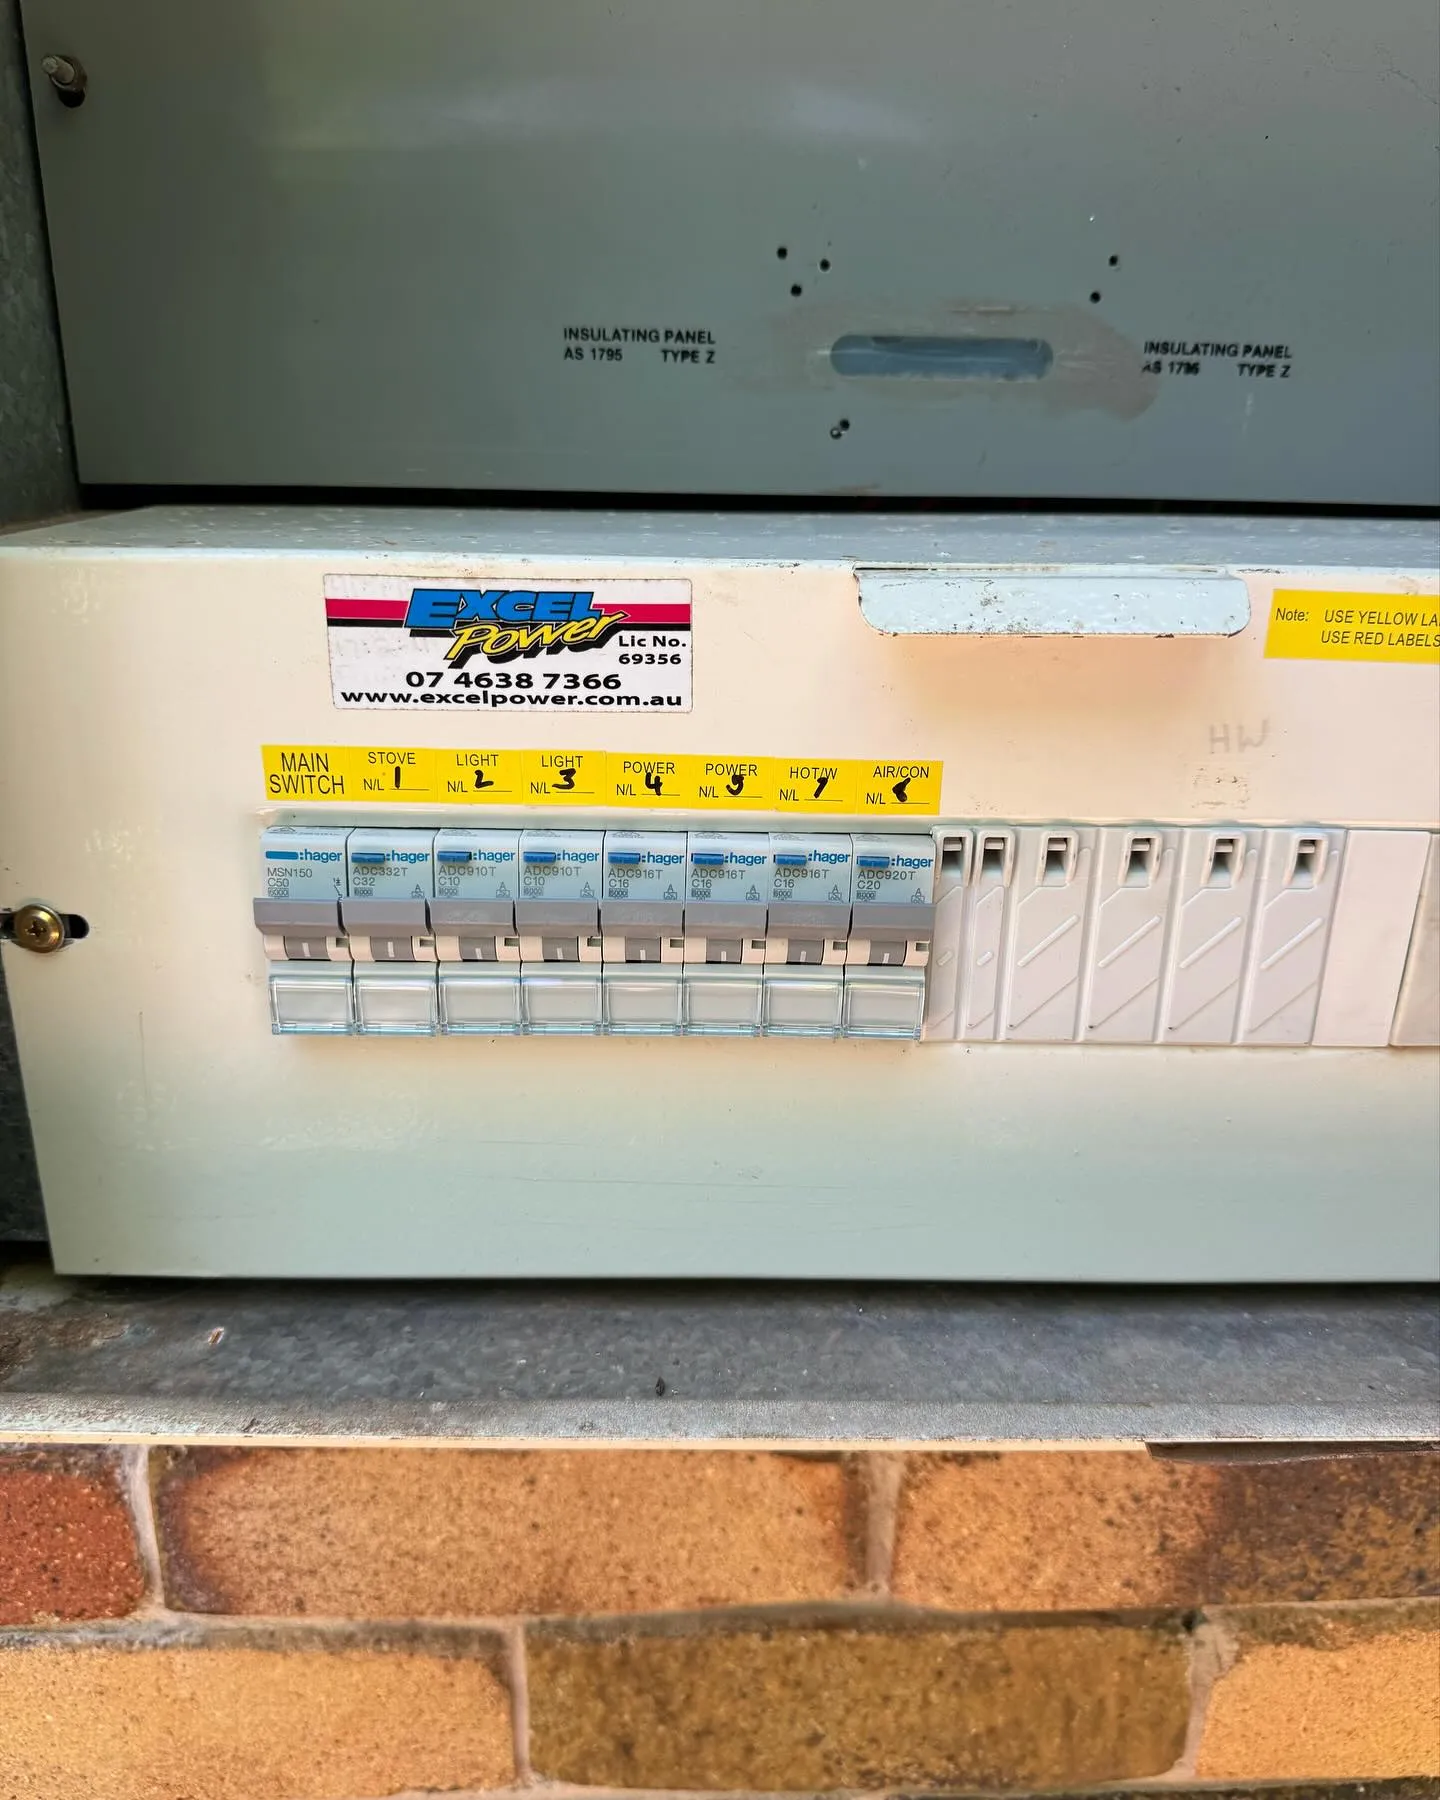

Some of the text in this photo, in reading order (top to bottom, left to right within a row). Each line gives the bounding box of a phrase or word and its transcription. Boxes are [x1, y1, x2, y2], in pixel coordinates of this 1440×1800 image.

[563, 327, 716, 345] INSULATING PANEL
[563, 346, 716, 364] AS 1795 TYPE Z
[1143, 341, 1292, 359] INSULATING PANEL
[1237, 363, 1275, 378] TYPE
[1280, 364, 1292, 378] Z
[404, 588, 602, 629] EXCEL
[1275, 607, 1440, 627] Note: USE YELLOW LA
[444, 611, 629, 660] Power
[618, 635, 686, 648] Lic No.
[1321, 630, 1440, 648] USE RED LABELS
[618, 653, 682, 665] 69356
[405, 672, 622, 690] 07 4638 7366
[341, 690, 683, 708] www.excelpower.com.au
[281, 752, 330, 773] MAIN
[367, 752, 417, 765] STOVE
[456, 754, 500, 767] LIGHT
[541, 755, 584, 768] LIGHT
[623, 761, 675, 775] POWER
[705, 763, 758, 777] POWER
[789, 766, 838, 780] HOT/W
[873, 765, 930, 778] AIR/CON
[394, 766, 401, 789] 1
[474, 769, 494, 789] 2
[551, 767, 577, 790] 3
[644, 771, 663, 796] 4
[269, 774, 345, 795] SWITCH
[363, 778, 385, 792] N/L
[447, 780, 469, 793] N/L
[530, 781, 551, 795] N/L
[616, 783, 637, 796] N/L
[725, 774, 745, 796] 5
[812, 776, 829, 798] 7
[698, 785, 719, 798] N/L
[779, 788, 800, 801] N/L
[866, 792, 886, 805] N/L
[267, 867, 313, 878] MSN150
[352, 866, 408, 876] ADC332T
[438, 866, 496, 876] ADC910T
[523, 866, 582, 876] ADC910T
[608, 868, 663, 879] ADC916T
[691, 868, 746, 880] ADC916T
[774, 868, 830, 879] ADC916T
[857, 870, 916, 880] ADC920T
[267, 877, 290, 887] C50
[353, 877, 376, 886] C32
[438, 876, 460, 886] C10
[523, 876, 545, 886] C10
[608, 879, 629, 888] C16
[691, 879, 712, 888] C16
[773, 879, 795, 888] C16
[857, 881, 881, 890] C20
